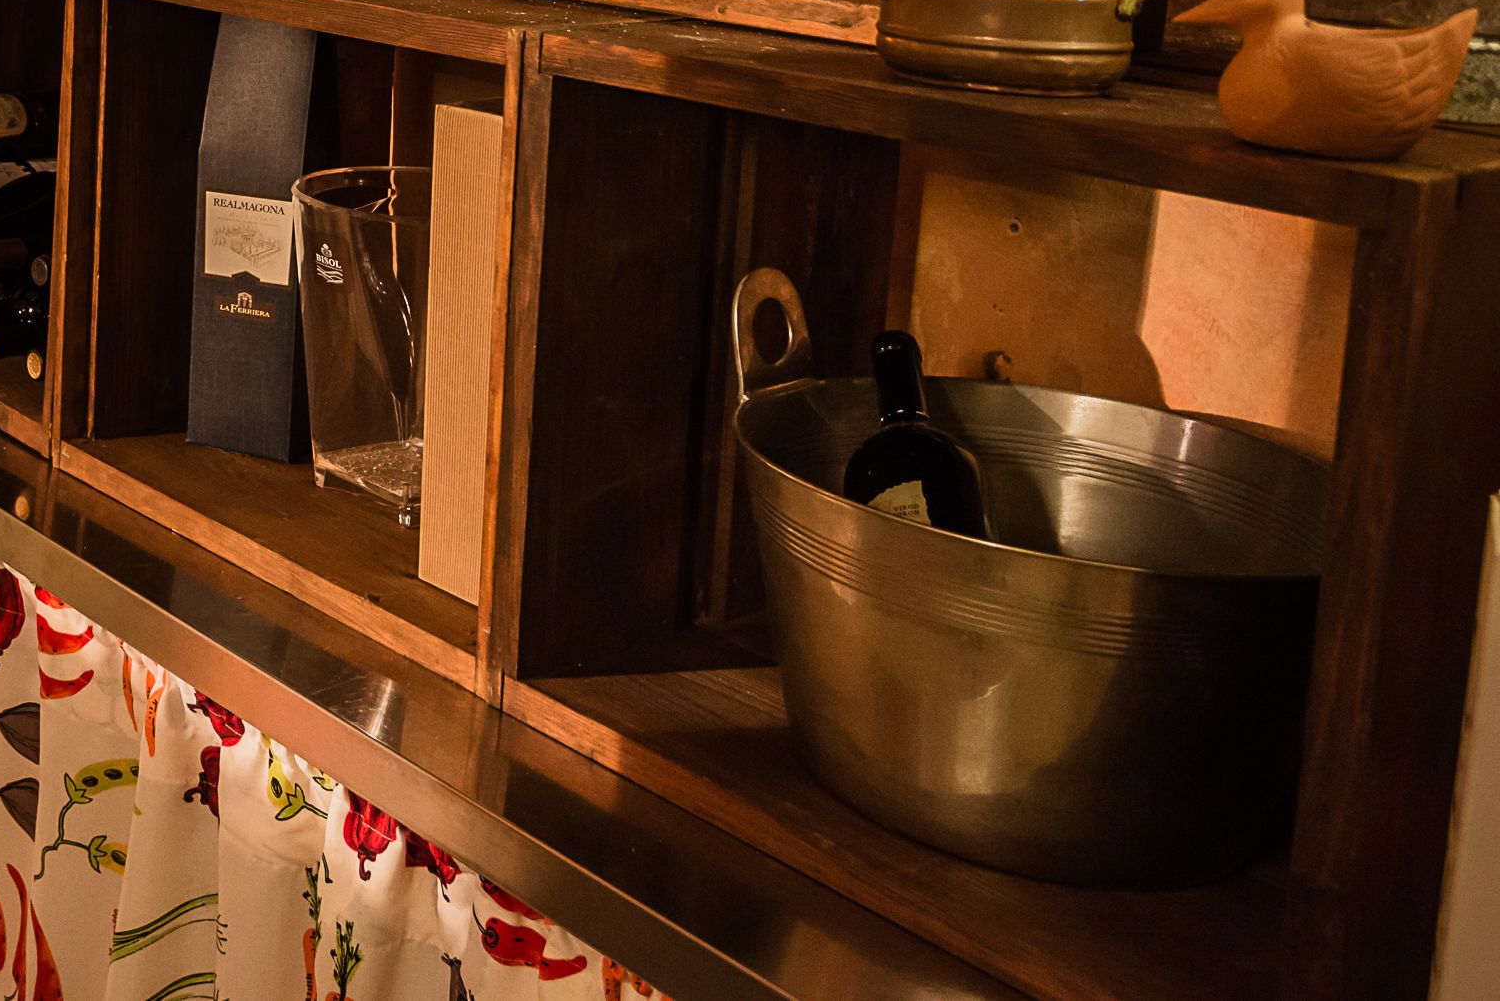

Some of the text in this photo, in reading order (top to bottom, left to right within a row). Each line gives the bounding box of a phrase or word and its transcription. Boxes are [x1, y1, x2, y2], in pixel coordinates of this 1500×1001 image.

[213, 197, 285, 215] REALMAGONA
[315, 252, 342, 269] BISOL
[229, 303, 270, 318] FERRIERA
